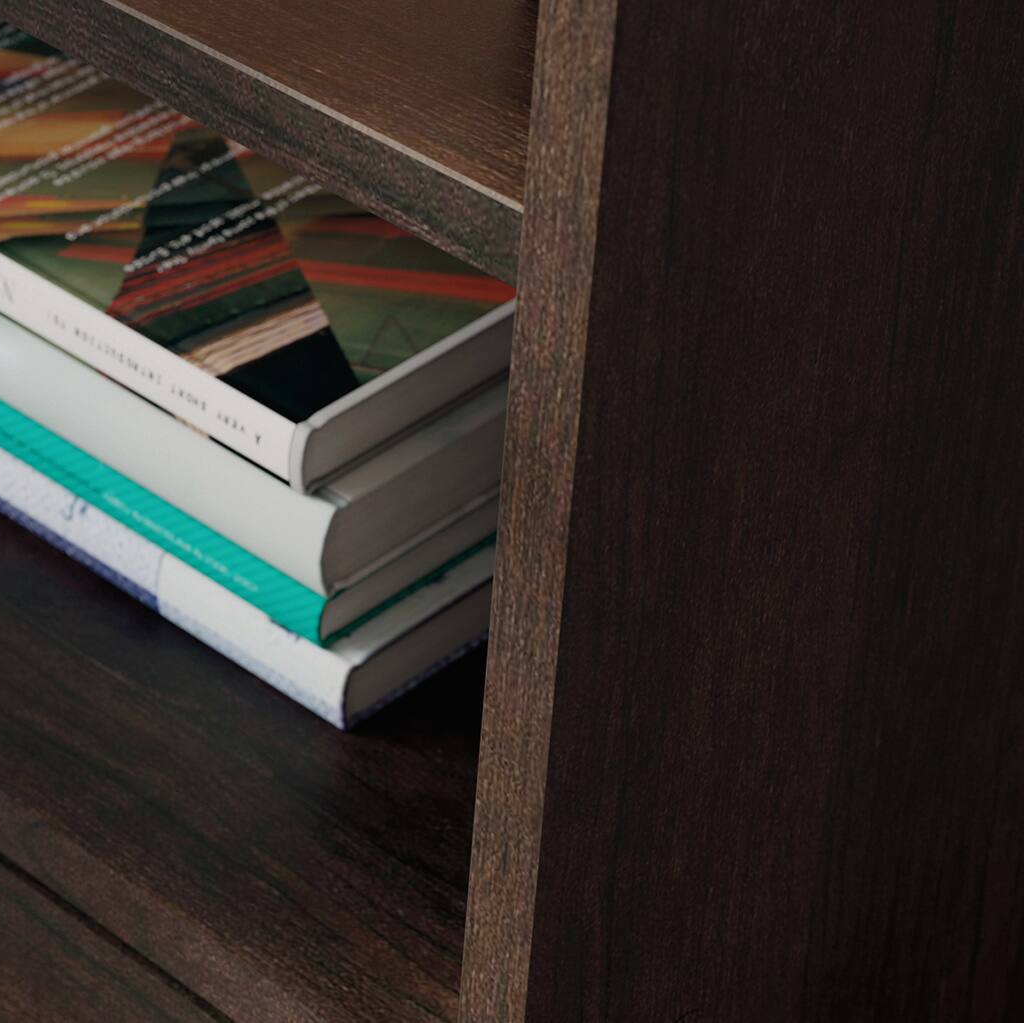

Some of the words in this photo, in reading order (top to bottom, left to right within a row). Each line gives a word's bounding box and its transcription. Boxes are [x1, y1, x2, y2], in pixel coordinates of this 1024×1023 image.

[74, 327, 163, 387] INTRODUCTION
[170, 385, 208, 413] SHORT
[216, 408, 248, 433] VERY
[254, 433, 263, 446] A
